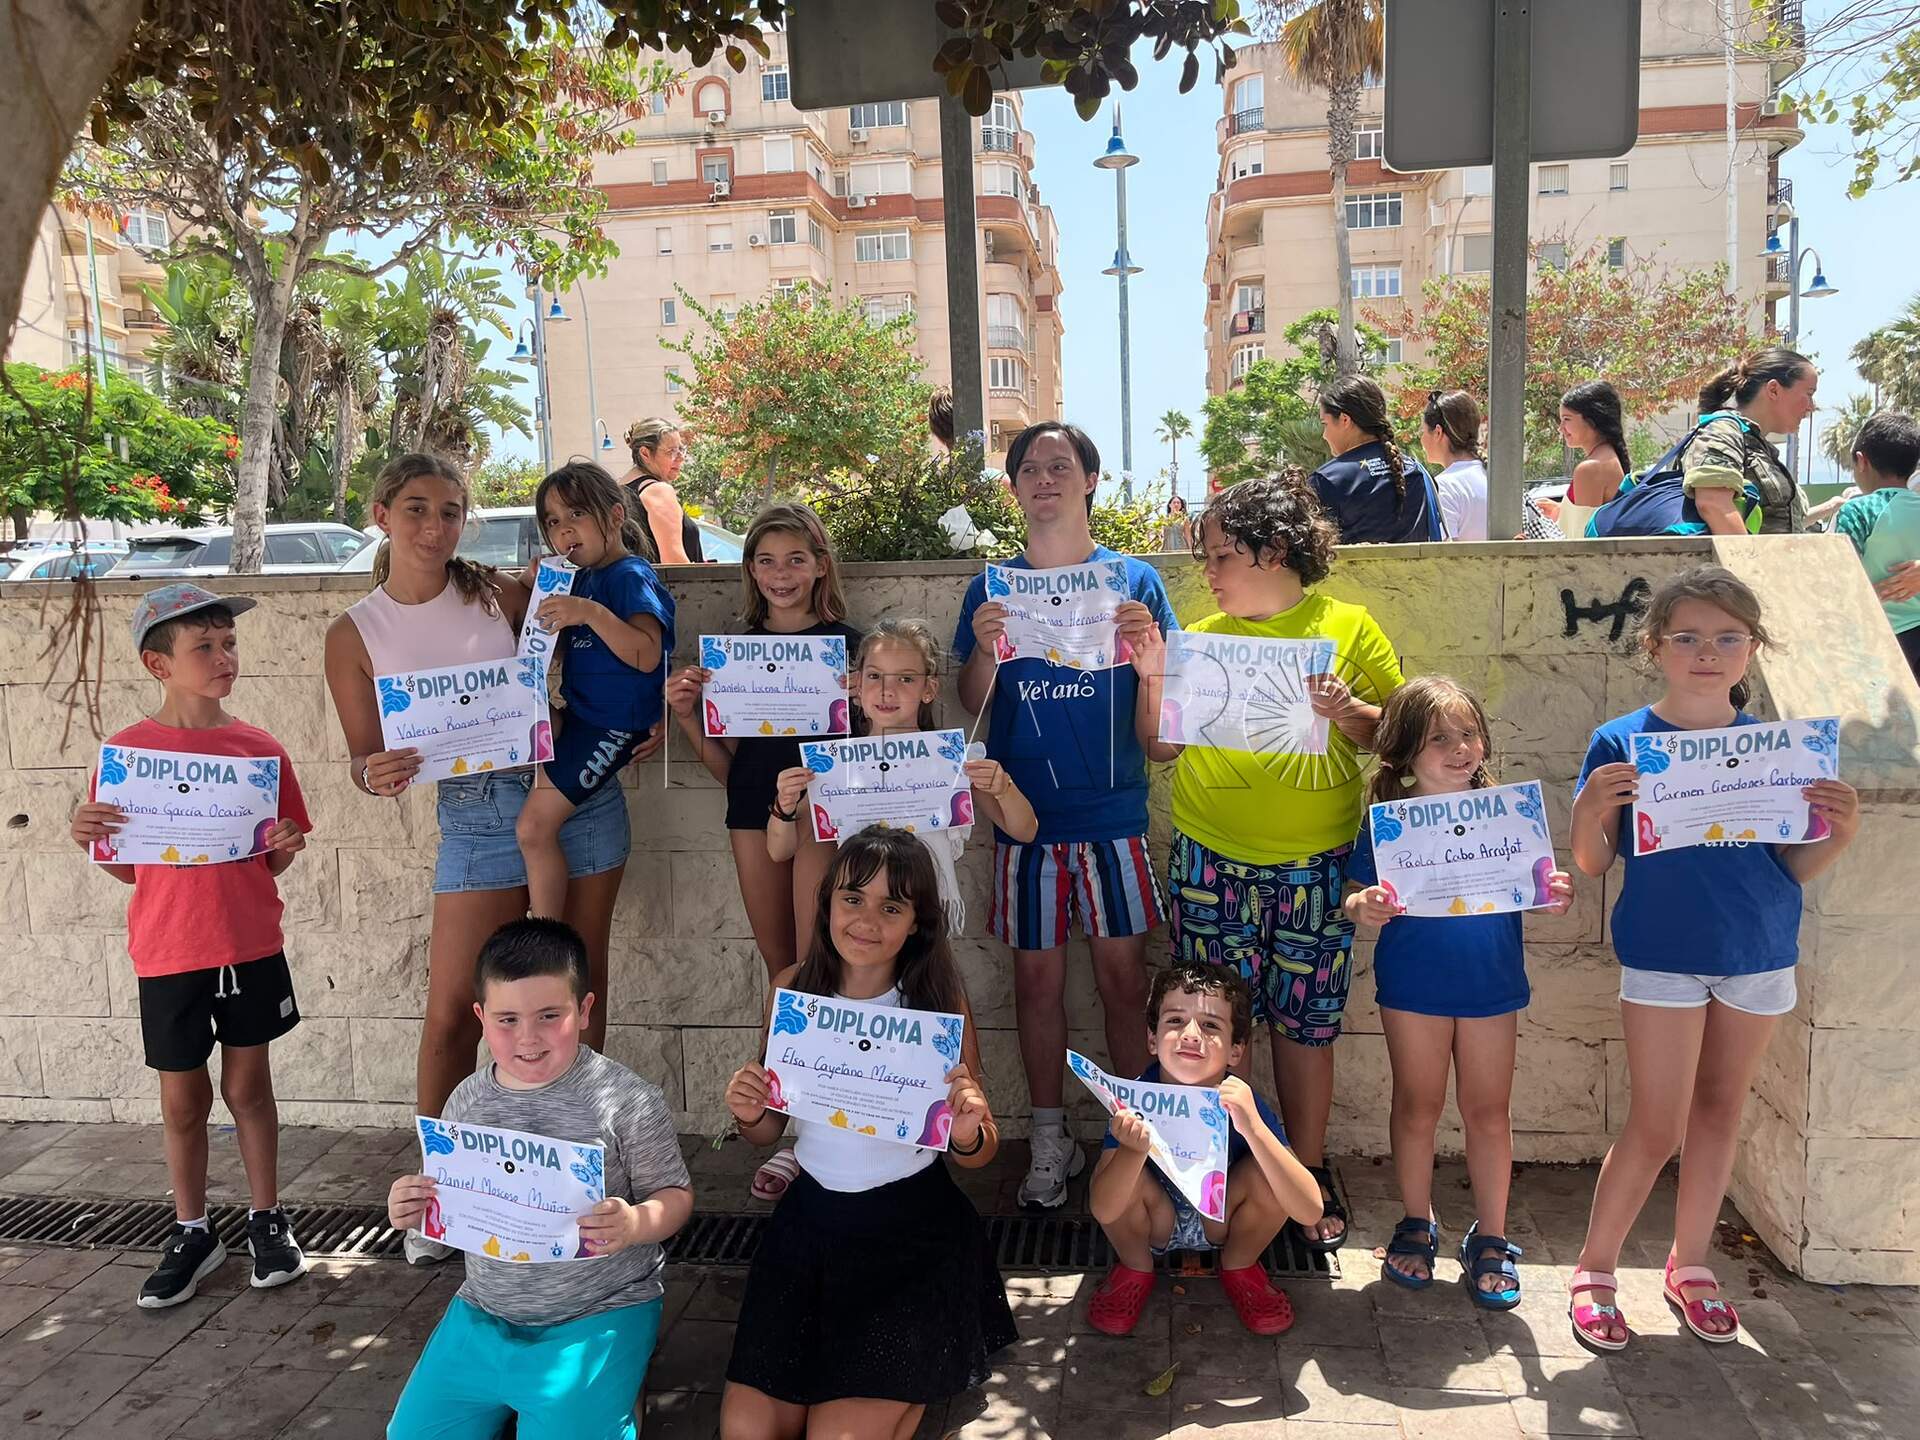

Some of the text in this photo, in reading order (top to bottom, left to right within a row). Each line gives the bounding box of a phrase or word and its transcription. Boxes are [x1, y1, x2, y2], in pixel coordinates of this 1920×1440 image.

[1016, 570, 1099, 596] DIPLOMA
[733, 642, 813, 662] DIPLOMA
[418, 666, 510, 699] DIPLOMA
[712, 681, 747, 695] Daniela
[397, 722, 440, 740] Valeria
[1681, 729, 1791, 762] DIPLOMA
[839, 739, 930, 763] DIPLOMA
[136, 756, 238, 785] DIPLOMA
[1653, 783, 1704, 803] Carmen
[163, 802, 203, 821] García
[209, 803, 254, 818] Ocaña
[1409, 795, 1508, 828] DIPLOMA
[1391, 837, 1522, 868] Paola Cabo Arrufat
[817, 1005, 922, 1045] DIPLOMA
[782, 1047, 927, 1093] Elsa Cayetano Márquez
[1100, 1075, 1190, 1118] DIPLOMA
[461, 1130, 561, 1171] DIPLOMA
[437, 1167, 476, 1190] Daniel
[481, 1177, 519, 1203] Moscoso
